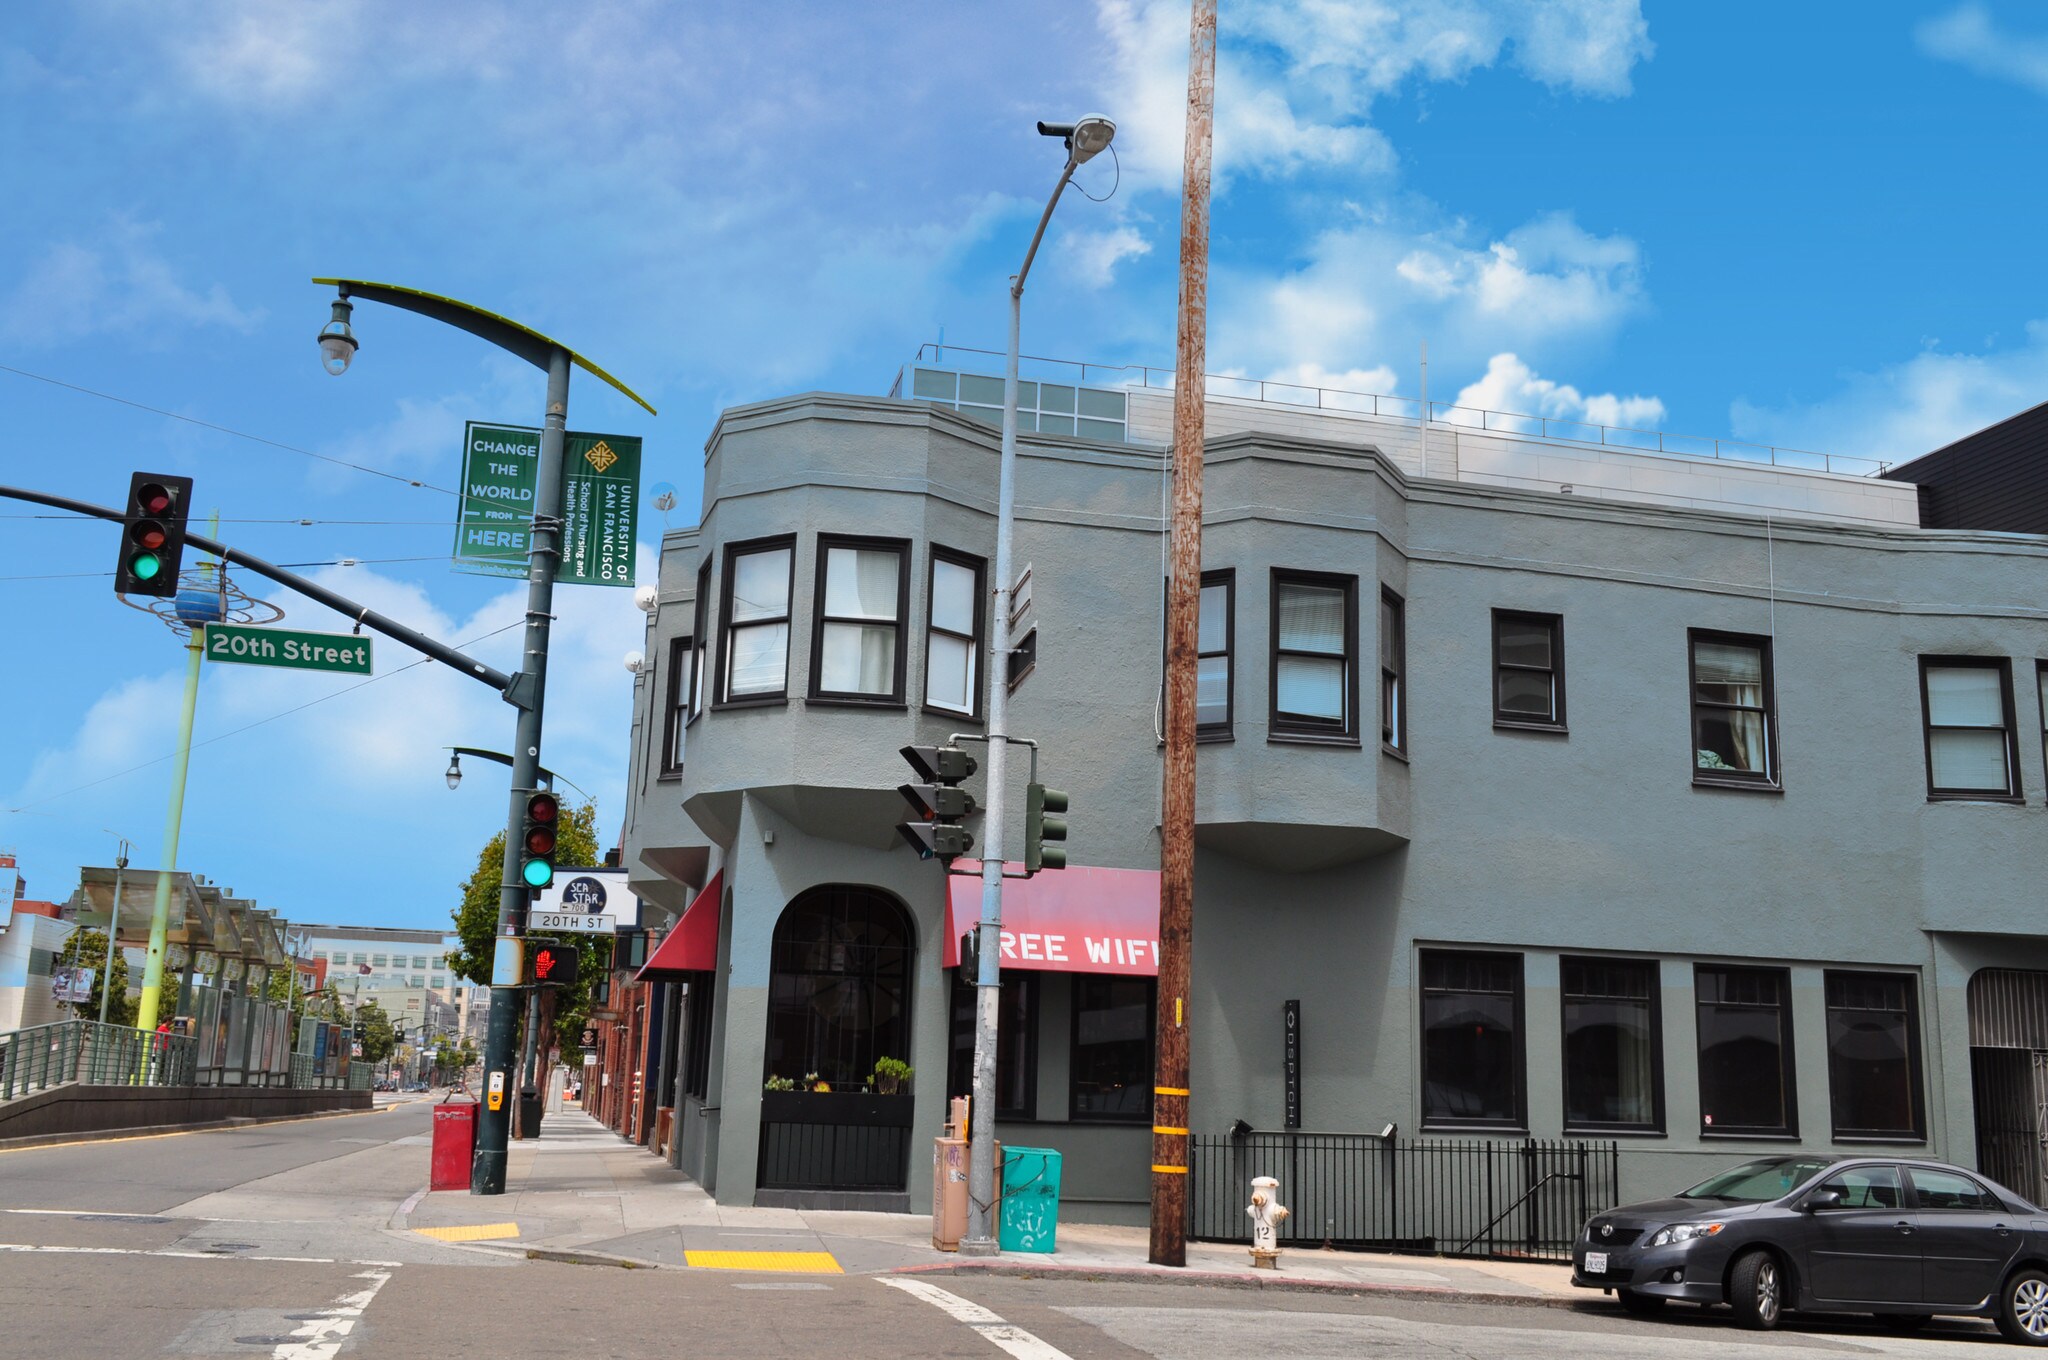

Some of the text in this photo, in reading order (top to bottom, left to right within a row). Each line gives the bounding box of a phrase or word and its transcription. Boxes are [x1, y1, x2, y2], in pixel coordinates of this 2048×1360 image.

[474, 440, 537, 457] CHANGE
[488, 463, 519, 476] THE
[471, 484, 532, 501] WORLD
[580, 482, 591, 513] School
[485, 511, 513, 520] FROM
[563, 481, 577, 563] Health Professions
[468, 530, 525, 548] HERE
[575, 522, 589, 559] Nursing
[601, 484, 616, 580] SAN FRANCISCO
[616, 485, 632, 581] UNIVERSITY OF
[576, 559, 586, 577] and
[212, 633, 366, 665] 20th Street
[570, 883, 589, 893] SEA
[572, 893, 599, 904] STAR
[542, 915, 604, 928] 20TH ST
[999, 931, 1069, 962] REE
[1256, 1226, 1270, 1240] 12
